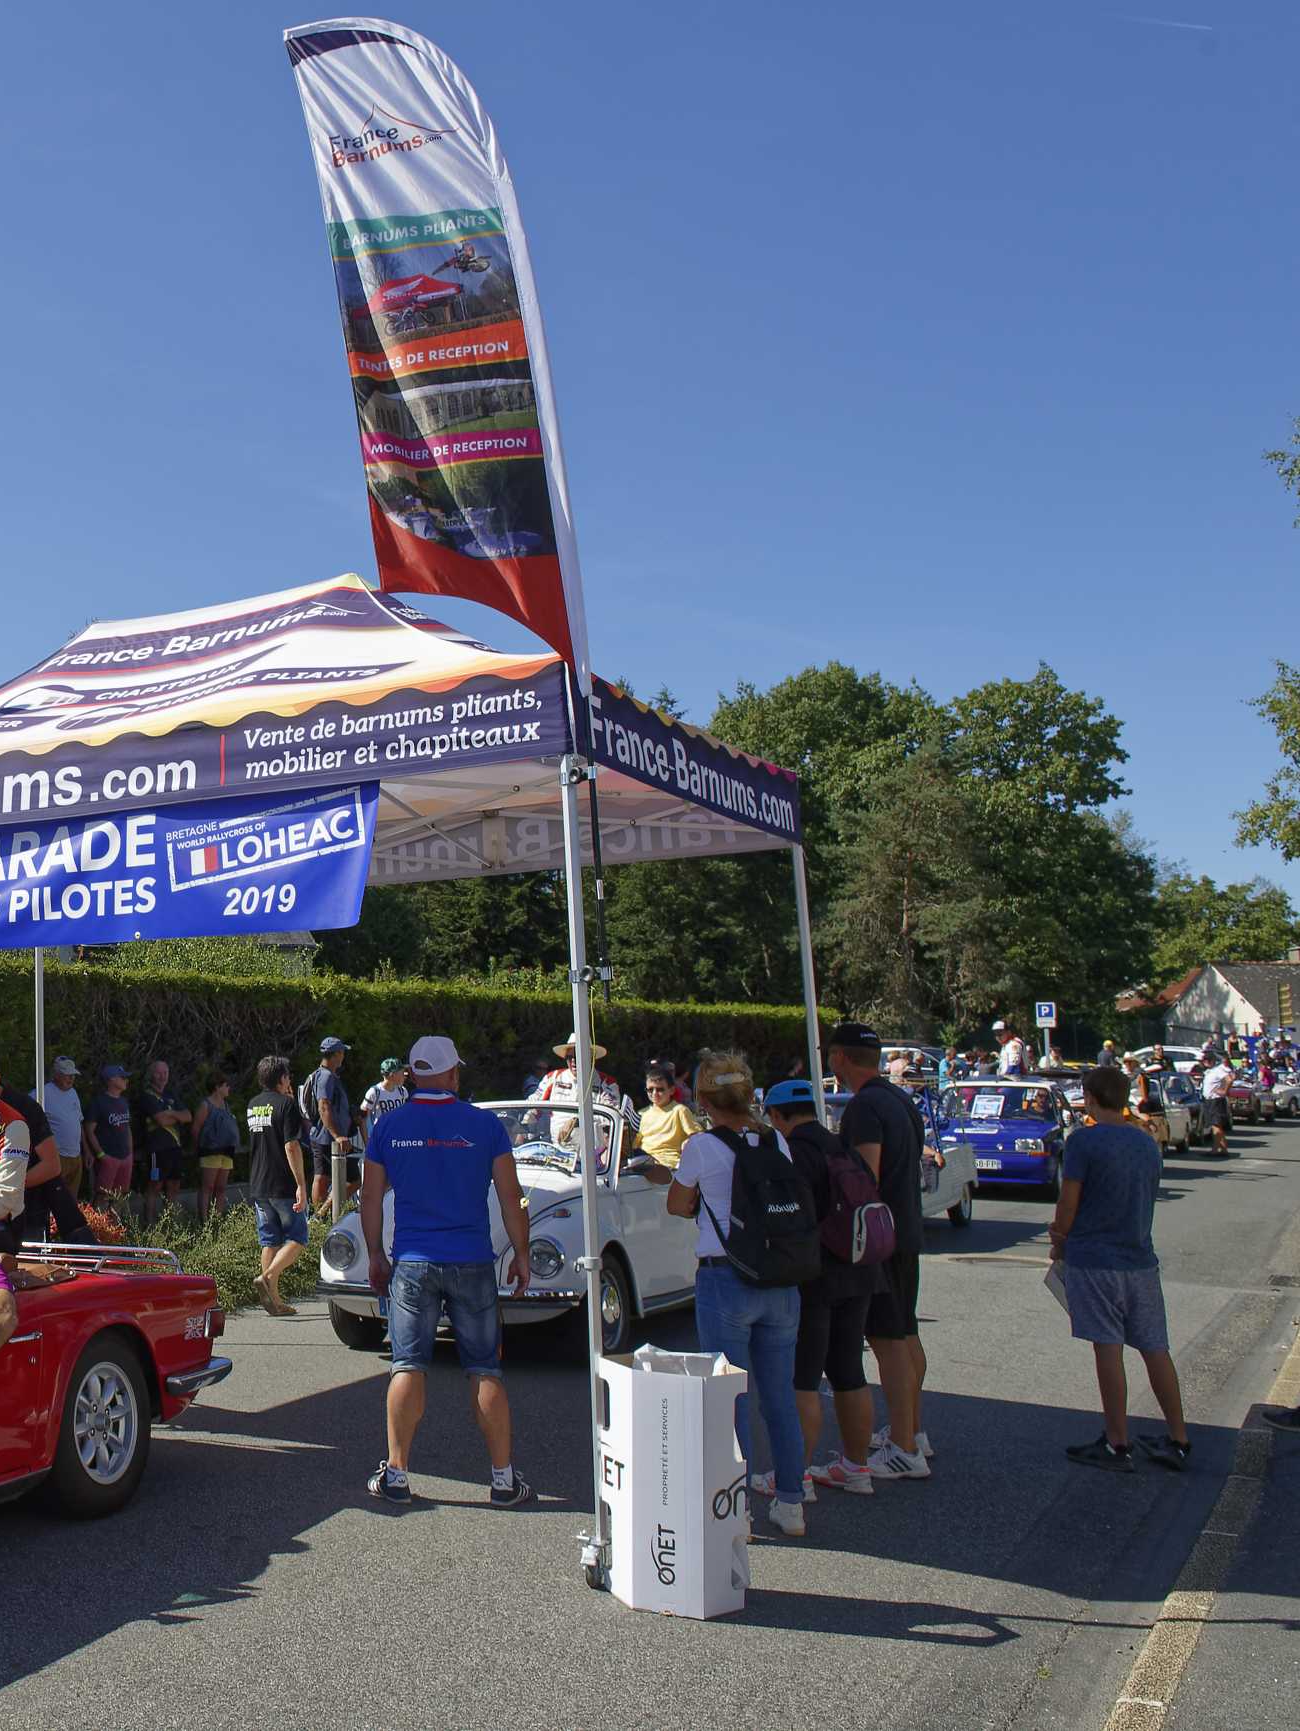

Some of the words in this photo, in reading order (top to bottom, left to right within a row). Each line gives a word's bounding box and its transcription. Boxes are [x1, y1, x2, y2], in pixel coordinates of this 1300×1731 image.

[329, 125, 399, 152] France
[343, 224, 419, 250] BARNUMS
[423, 214, 487, 237] PLIANTS
[358, 353, 403, 373] TENTES
[406, 350, 425, 364] DE
[428, 340, 509, 361] RECEPTION
[371, 443, 430, 461] MOBILIER
[433, 446, 449, 458] DE
[453, 437, 528, 454] RECEPTION
[95, 661, 243, 700] CHAPITEAUX
[261, 667, 381, 682] PLIANTS
[244, 724, 305, 750] Vente
[310, 715, 336, 741] de
[341, 704, 444, 736] barnums
[450, 689, 542, 724] pliants,
[245, 747, 348, 780] mobilier
[354, 742, 379, 766] et
[385, 721, 541, 760] chapiteaux
[166, 820, 218, 841] BRETAGNE
[176, 837, 205, 850] WORLD
[207, 826, 253, 846] RALLYCROSS
[255, 821, 266, 831] OF
[222, 809, 354, 869] LOHEAC
[9, 876, 157, 923] PILOTES
[223, 883, 297, 916] 2019
